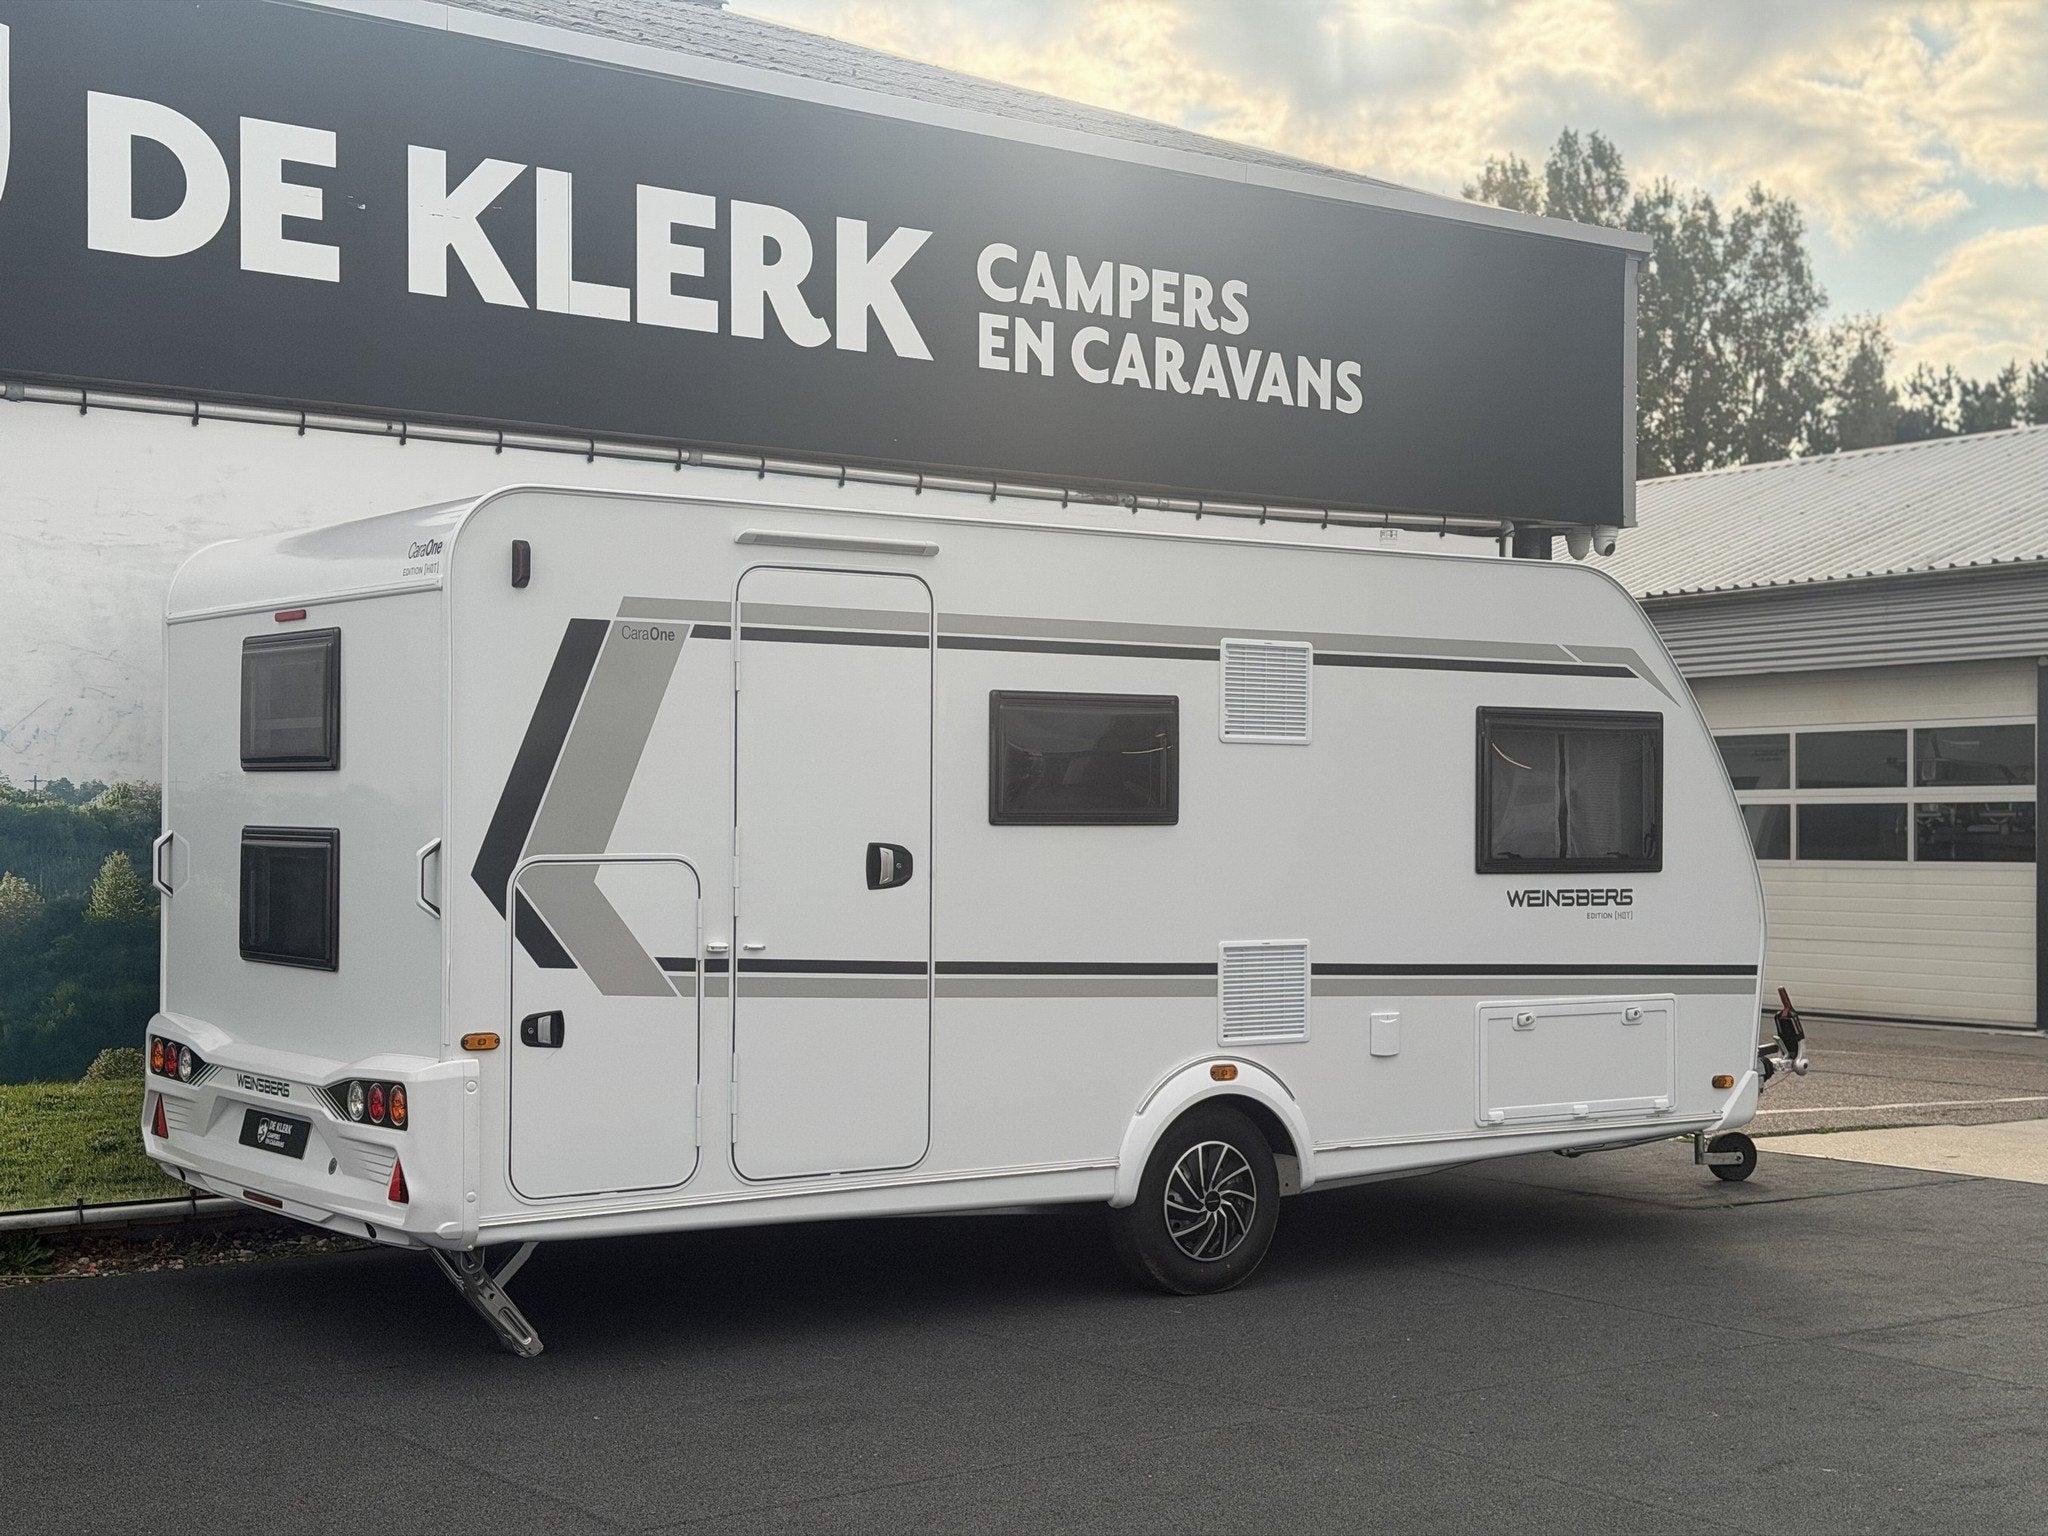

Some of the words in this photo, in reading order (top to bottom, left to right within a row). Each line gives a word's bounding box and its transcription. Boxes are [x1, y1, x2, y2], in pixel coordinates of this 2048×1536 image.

[87, 90, 341, 283] DE
[407, 144, 935, 362] KLERK
[976, 242, 1250, 335] CAMPERS
[978, 312, 1055, 376] EN
[1071, 326, 1364, 414] CARAVANS
[408, 539, 443, 559] CaraOne
[402, 566, 423, 577] EDITION
[621, 625, 676, 641] CaraOne
[1506, 888, 1634, 908] WEINSBERG
[1586, 911, 1613, 920] EDITION
[236, 1073, 290, 1098] WEINSBERG
[269, 1120, 277, 1131] DE
[276, 1122, 294, 1135] KLERK
